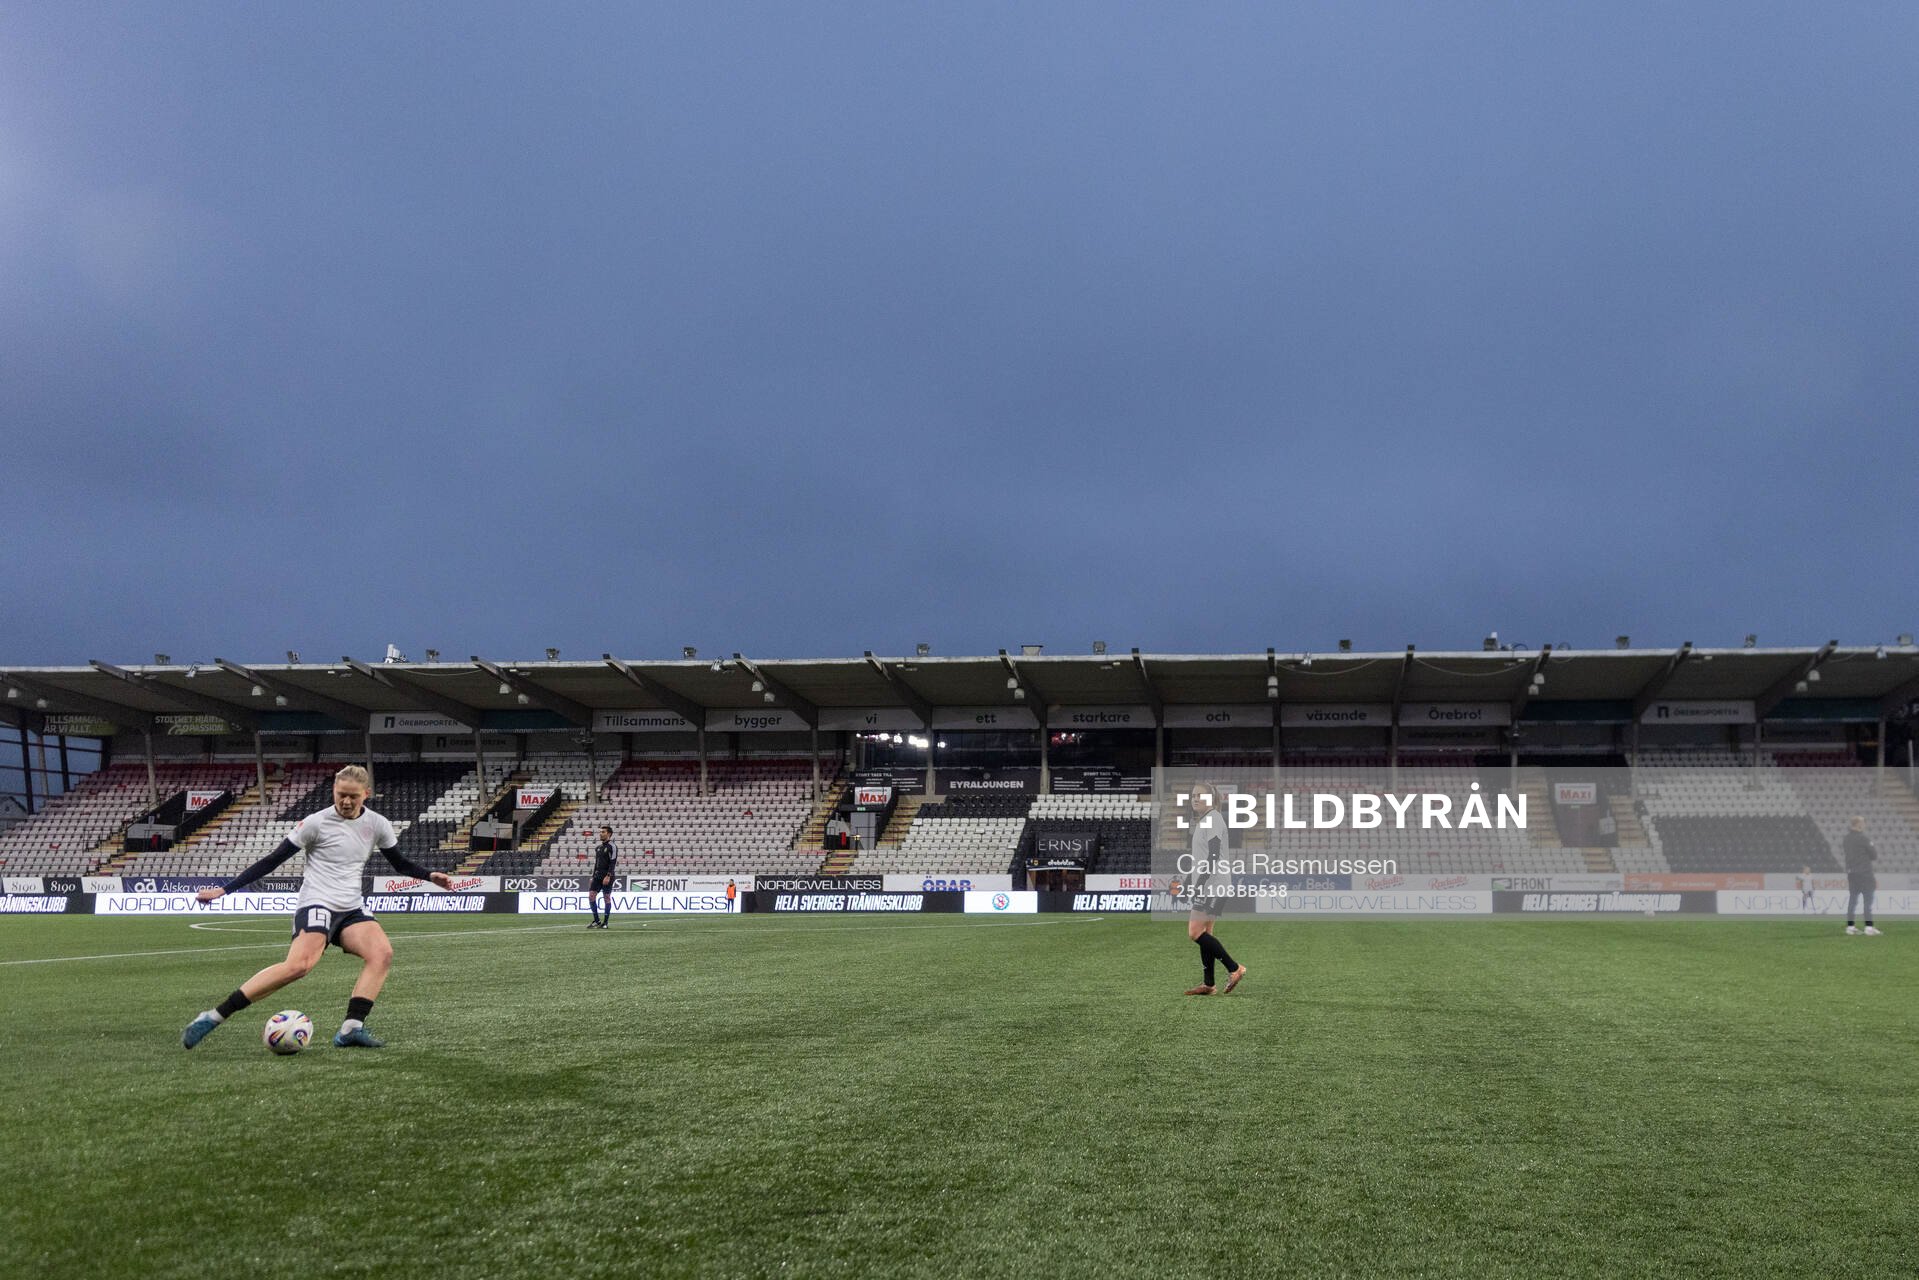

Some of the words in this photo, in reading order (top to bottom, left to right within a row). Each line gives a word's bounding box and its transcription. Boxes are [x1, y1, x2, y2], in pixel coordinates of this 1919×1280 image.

[866, 714, 877, 724] vi
[975, 714, 997, 724] ett
[1072, 712, 1130, 723] starkare
[1206, 711, 1230, 722] och
[1306, 710, 1367, 721] växande
[1429, 707, 1481, 720] Örebro!
[604, 716, 686, 726] Tillsammans
[735, 715, 782, 728] bygger
[521, 795, 546, 804] MAX
[1038, 839, 1095, 851] ERNST
[160, 880, 190, 892] Älska
[504, 879, 538, 890] RYDS
[547, 879, 580, 890] RYDS
[651, 879, 688, 891] FRONT
[756, 880, 881, 890] NORDICWELLNESS
[1513, 878, 1552, 889] FRONT
[366, 895, 409, 911] SVERIGES
[410, 893, 485, 911] TRÄNINGSKLUBB
[775, 895, 799, 911] HELA
[800, 895, 845, 911] SVERIGES
[846, 892, 924, 911] TRÄNINGSKLUBB
[1073, 894, 1097, 911] HELA
[1098, 894, 1145, 911] SVERIGES
